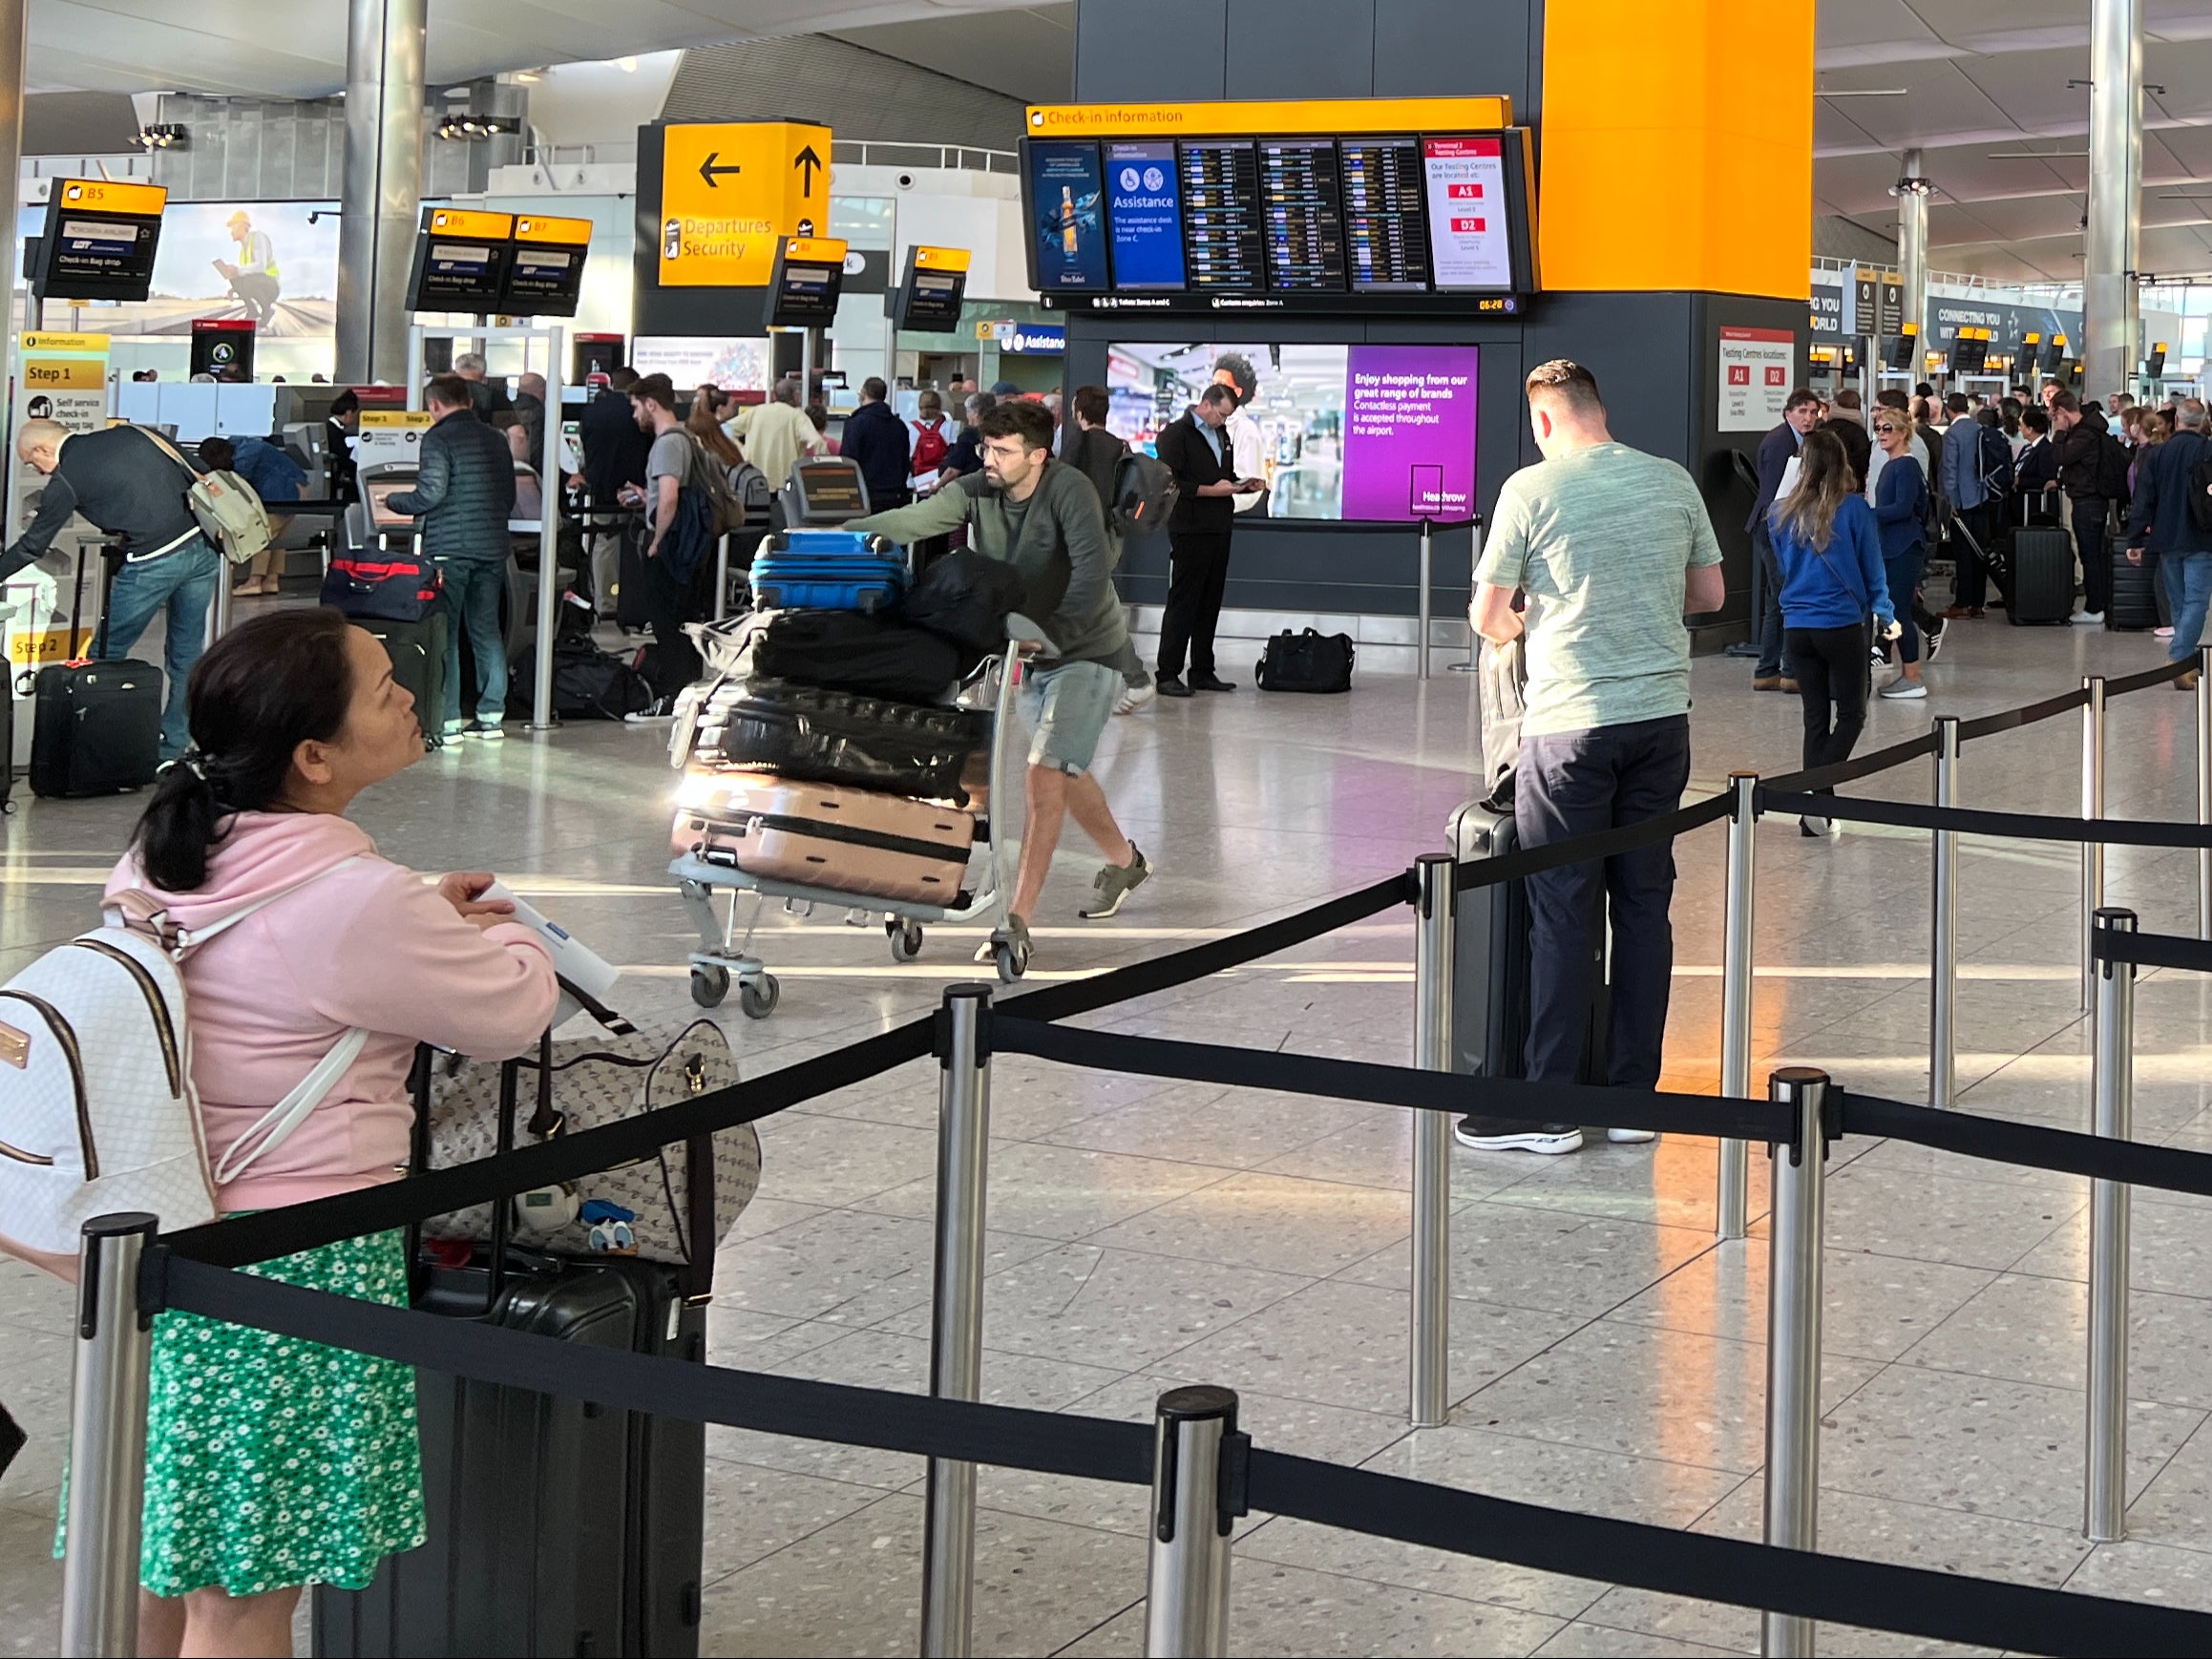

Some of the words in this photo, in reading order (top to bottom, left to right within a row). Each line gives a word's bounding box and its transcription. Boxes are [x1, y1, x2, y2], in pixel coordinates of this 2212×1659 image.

[1048, 110, 1103, 124] Check-in
[1105, 109, 1183, 123] information
[1444, 162, 1468, 172] Testing
[87, 188, 105, 200] B5
[1458, 185, 1473, 198] A1
[1114, 195, 1174, 209] Assistance
[451, 215, 464, 226] B6
[535, 221, 547, 232] B7
[1461, 220, 1476, 231] D2
[685, 219, 771, 237] Departures
[684, 241, 745, 260] Security
[1822, 298, 1841, 312] YOU
[1814, 317, 1838, 331] ORLD
[1938, 308, 1985, 325] CONNECTING
[1986, 313, 2001, 326] YOU
[1939, 326, 1955, 340] WIT
[1722, 347, 1742, 361] Testing
[1742, 347, 1762, 359] Centres
[30, 367, 60, 383] Step
[64, 368, 71, 380] 1
[1355, 373, 1380, 387] Enjoy
[1381, 373, 1425, 388] shopping
[1426, 373, 1449, 386] from
[1450, 375, 1467, 386] our
[1734, 368, 1744, 382] A1
[1770, 369, 1780, 383] D2
[1354, 388, 1379, 401] great
[1380, 389, 1407, 401] range
[1408, 388, 1420, 398] of
[1421, 388, 1453, 399] brands
[56, 398, 73, 407] Self
[1353, 400, 1397, 410] Contactless
[1398, 401, 1432, 412] payment
[363, 415, 381, 424] Step
[406, 415, 424, 424] Step
[1353, 413, 1359, 422] is
[1360, 414, 1395, 425] accepted
[1396, 414, 1440, 426] throughout
[1353, 426, 1366, 434] the
[1366, 426, 1394, 437] airport.
[15, 640, 47, 655] Step
[49, 639, 57, 652] 2
